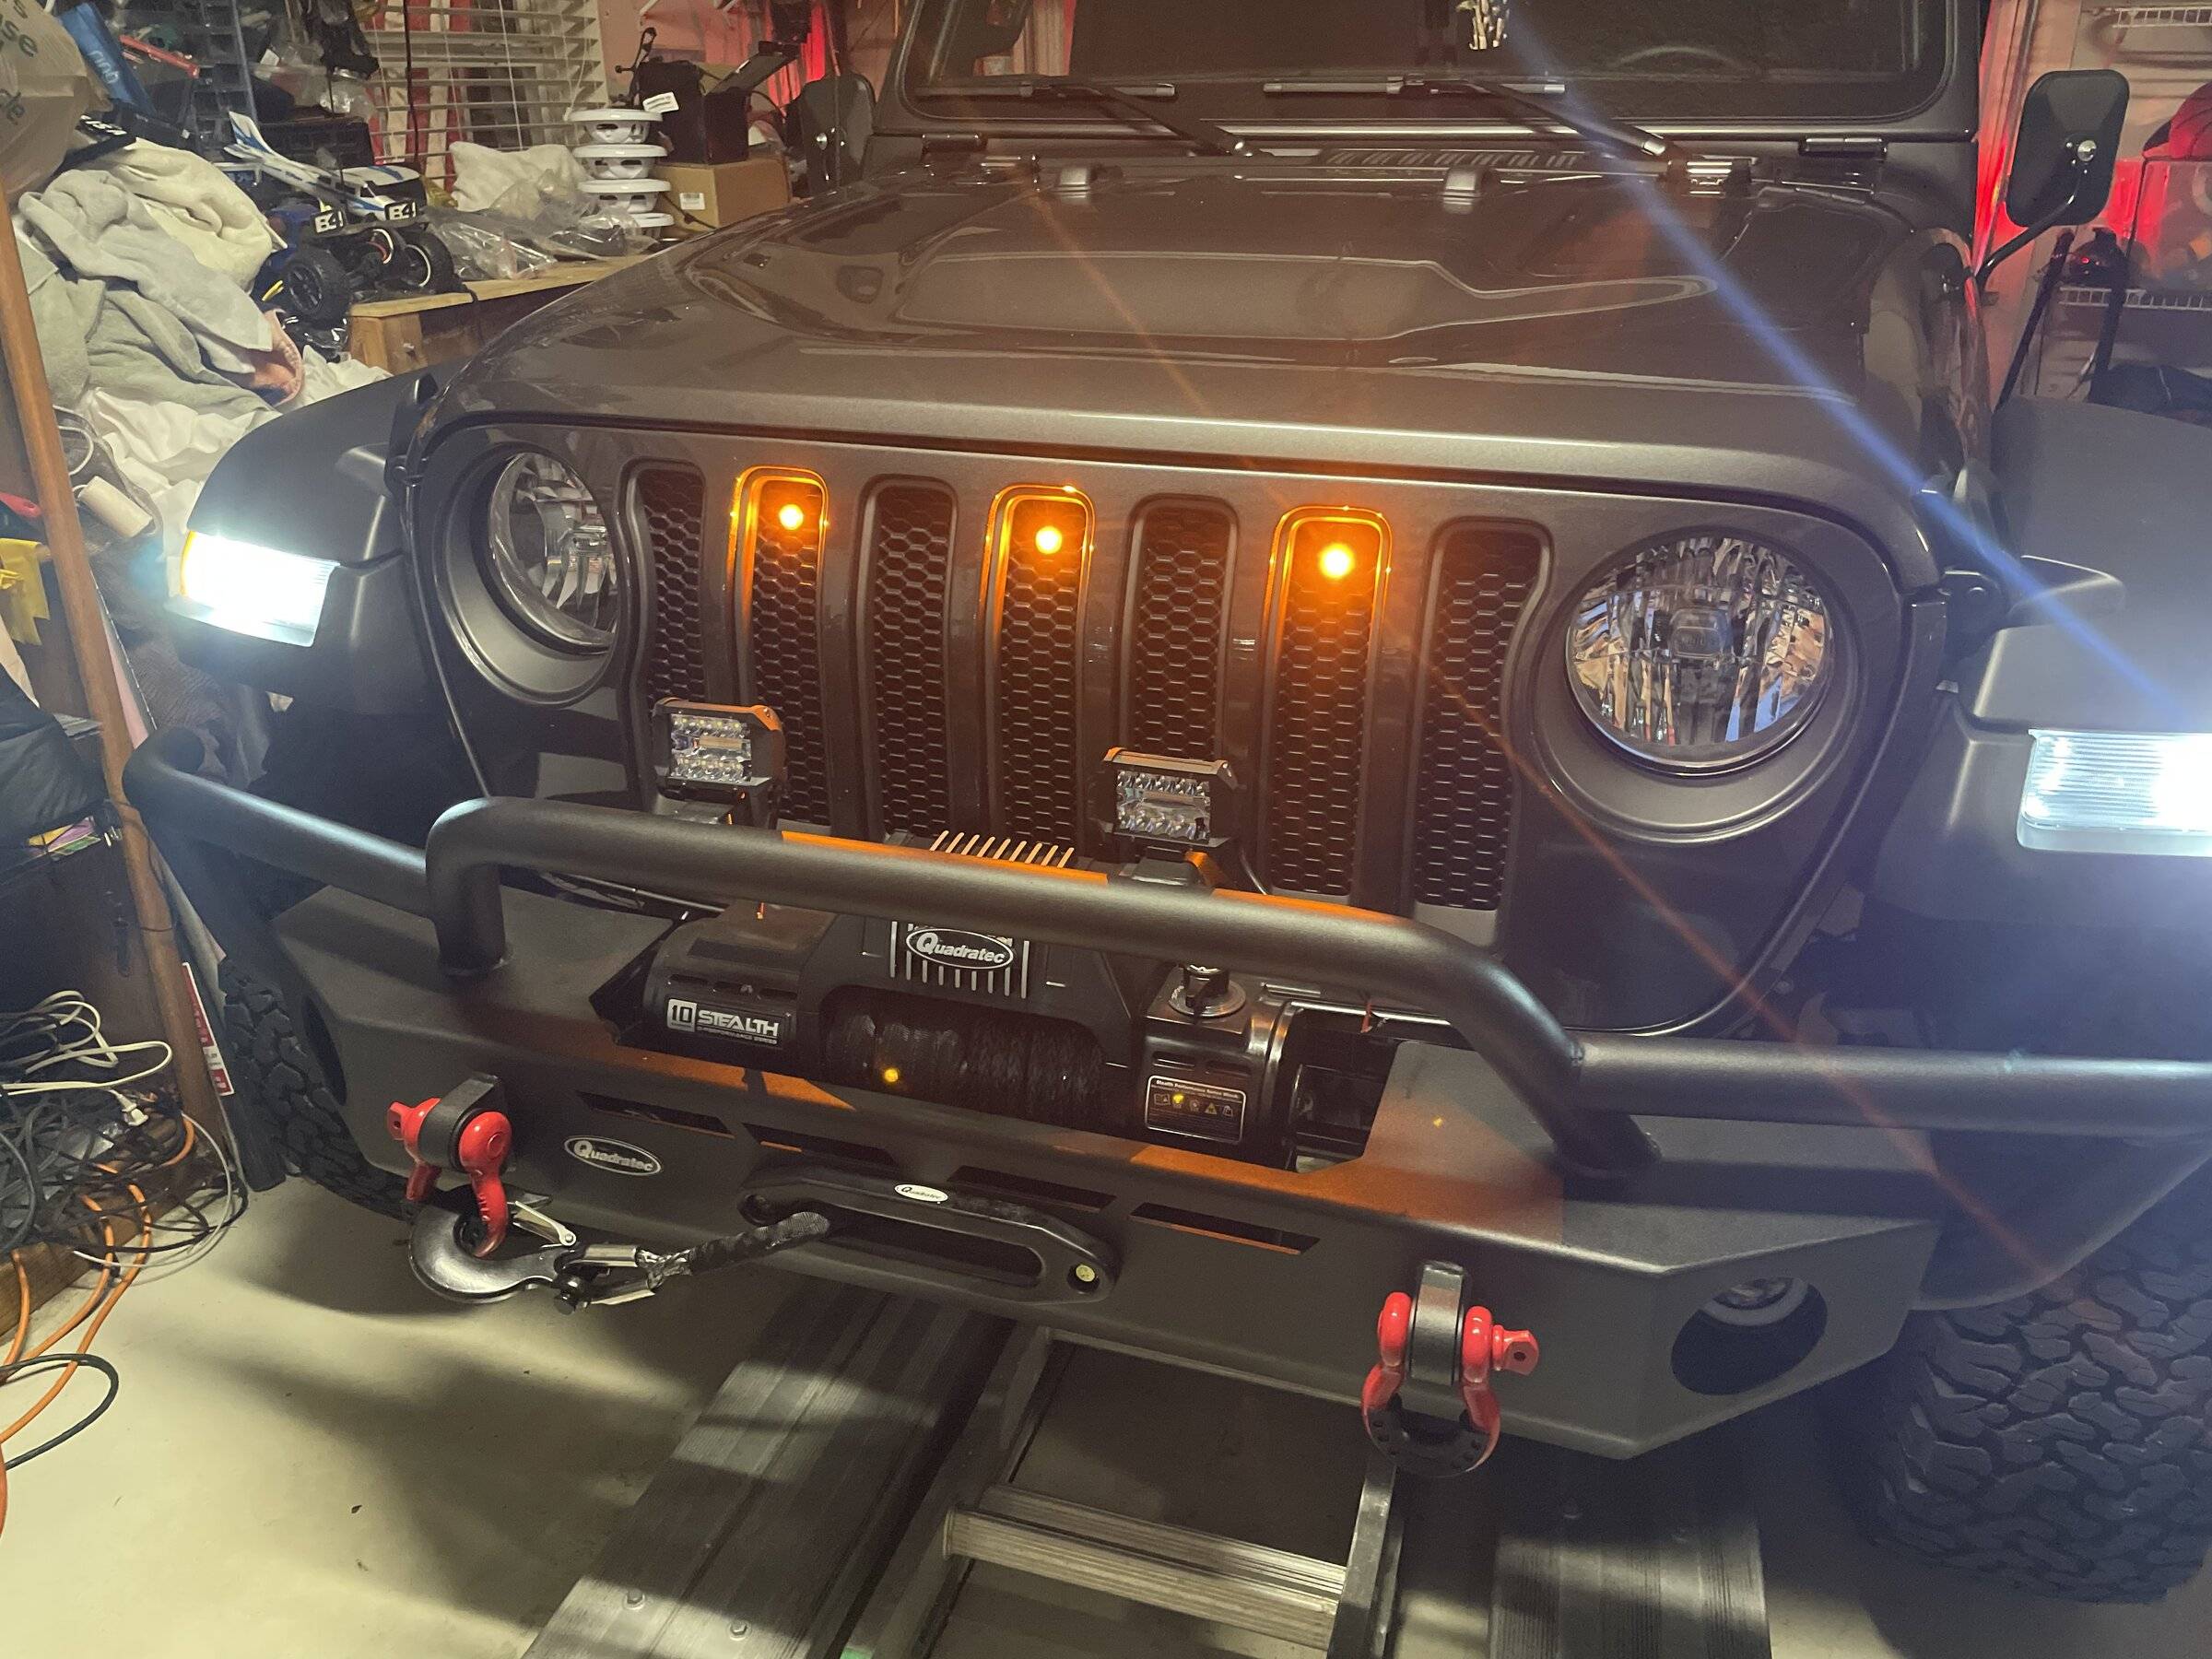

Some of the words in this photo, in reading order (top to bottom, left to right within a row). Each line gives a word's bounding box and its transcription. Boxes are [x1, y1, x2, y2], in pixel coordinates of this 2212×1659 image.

[916, 932, 1006, 964] Quadratec
[671, 1005, 693, 1024] 10
[698, 1009, 780, 1037] STEALTH
[573, 1140, 653, 1171] Quadratec
